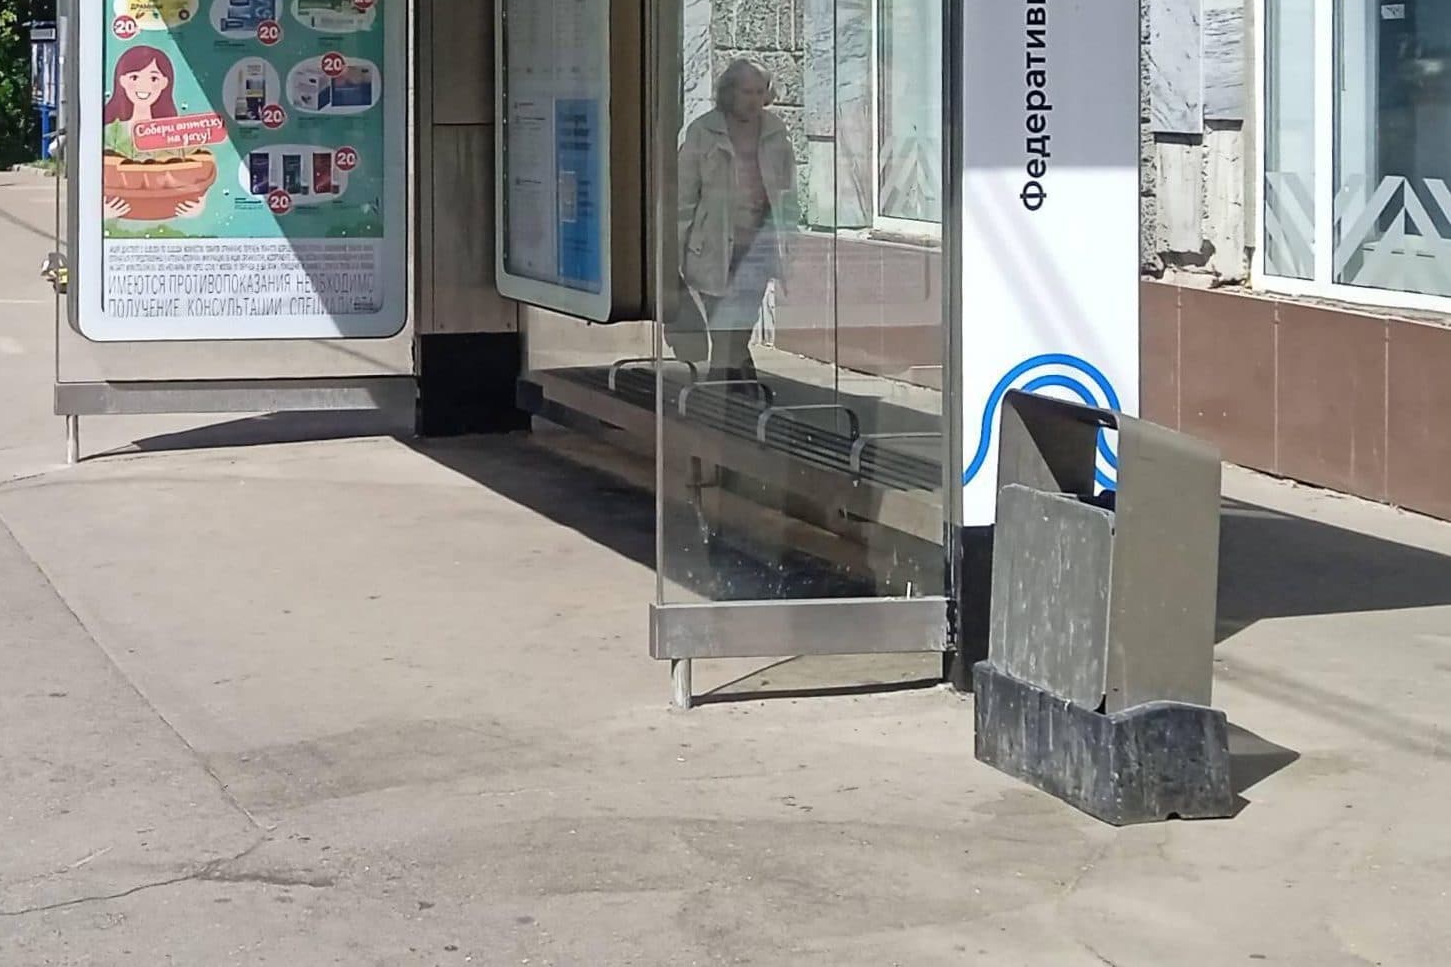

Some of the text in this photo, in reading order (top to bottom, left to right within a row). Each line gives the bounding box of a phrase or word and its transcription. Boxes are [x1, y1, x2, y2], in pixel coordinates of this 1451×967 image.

[115, 20, 135, 34] 20
[259, 26, 279, 39] 20
[323, 58, 343, 71] 20
[263, 110, 282, 123] 20
[135, 122, 175, 137] Собери
[167, 134, 181, 143] на
[336, 152, 356, 165] 20
[270, 196, 289, 209] 20
[109, 274, 166, 294] ИМЕЮТСЯ
[169, 273, 291, 294] ПРОТИВОПОКАЗАНИЯ
[109, 298, 181, 318] ПОЛУЧЕНИЕ
[188, 297, 282, 317] КОНСУЛЬТАЦИИ
